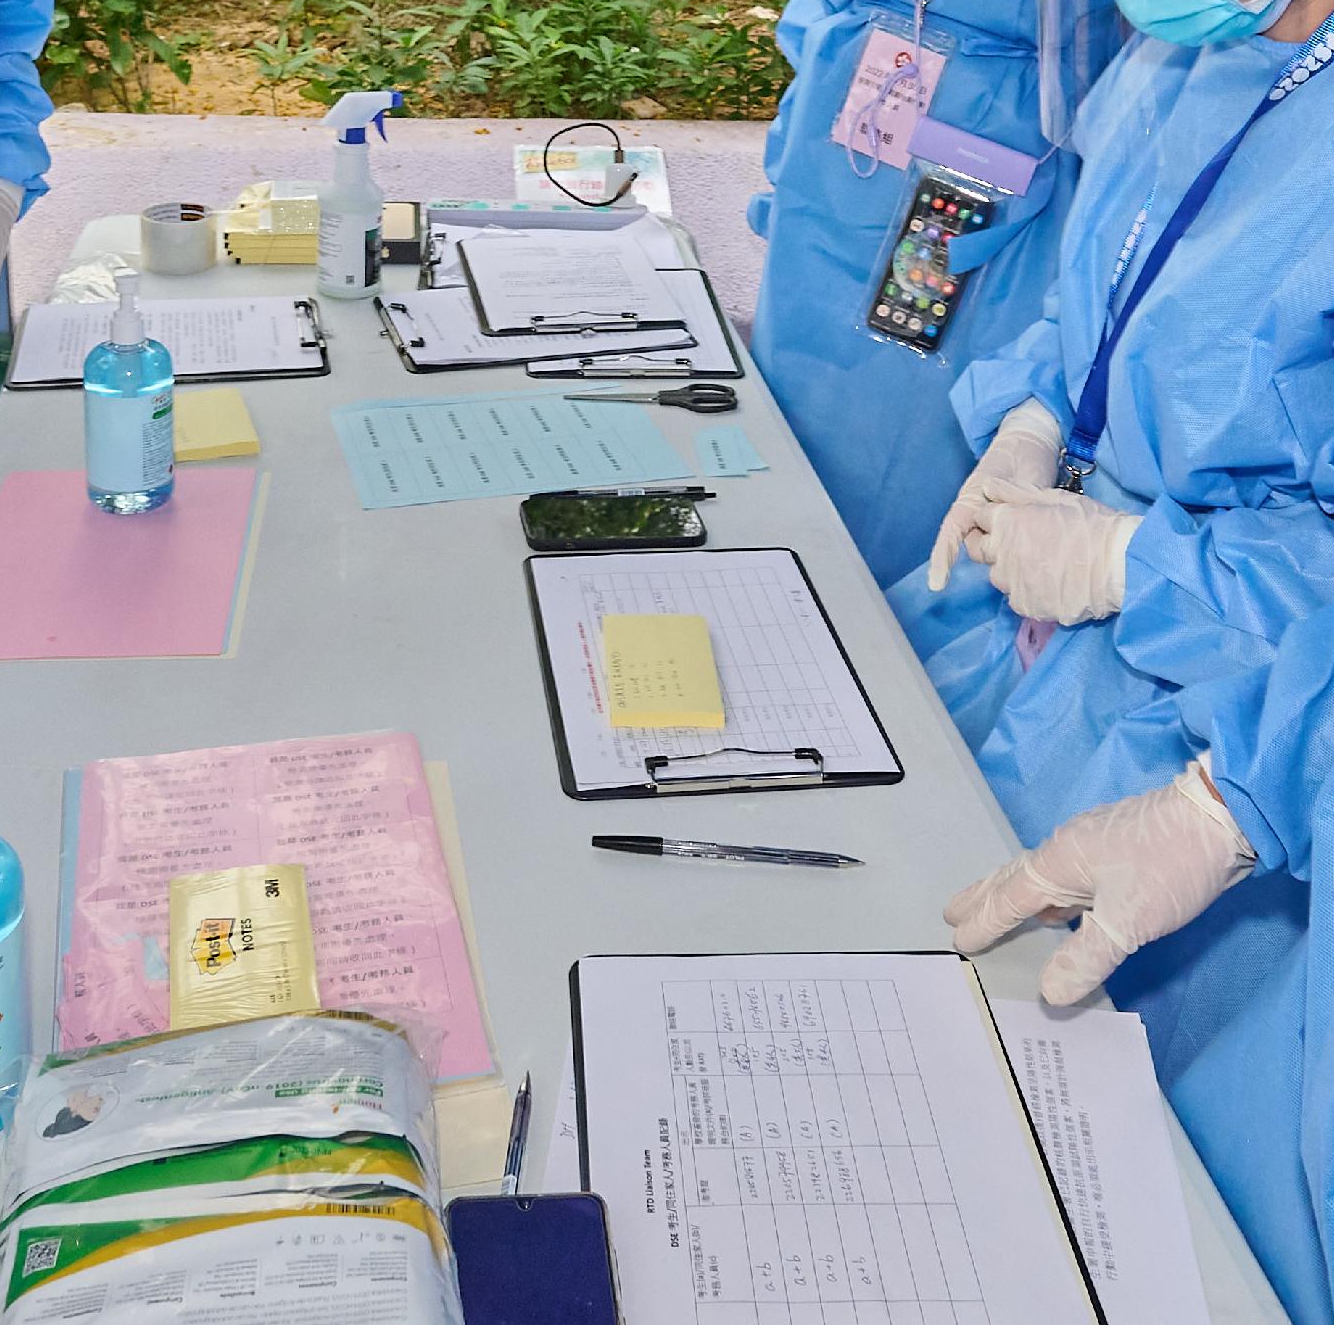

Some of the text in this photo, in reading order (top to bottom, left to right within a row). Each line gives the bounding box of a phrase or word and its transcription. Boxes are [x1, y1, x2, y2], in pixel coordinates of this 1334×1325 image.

[265, 878, 280, 899] 3M
[204, 921, 223, 969] Post-it
[241, 917, 255, 952] NOTES
[641, 1148, 656, 1215] RTD Liaison Team
[668, 1232, 680, 1249] DSE
